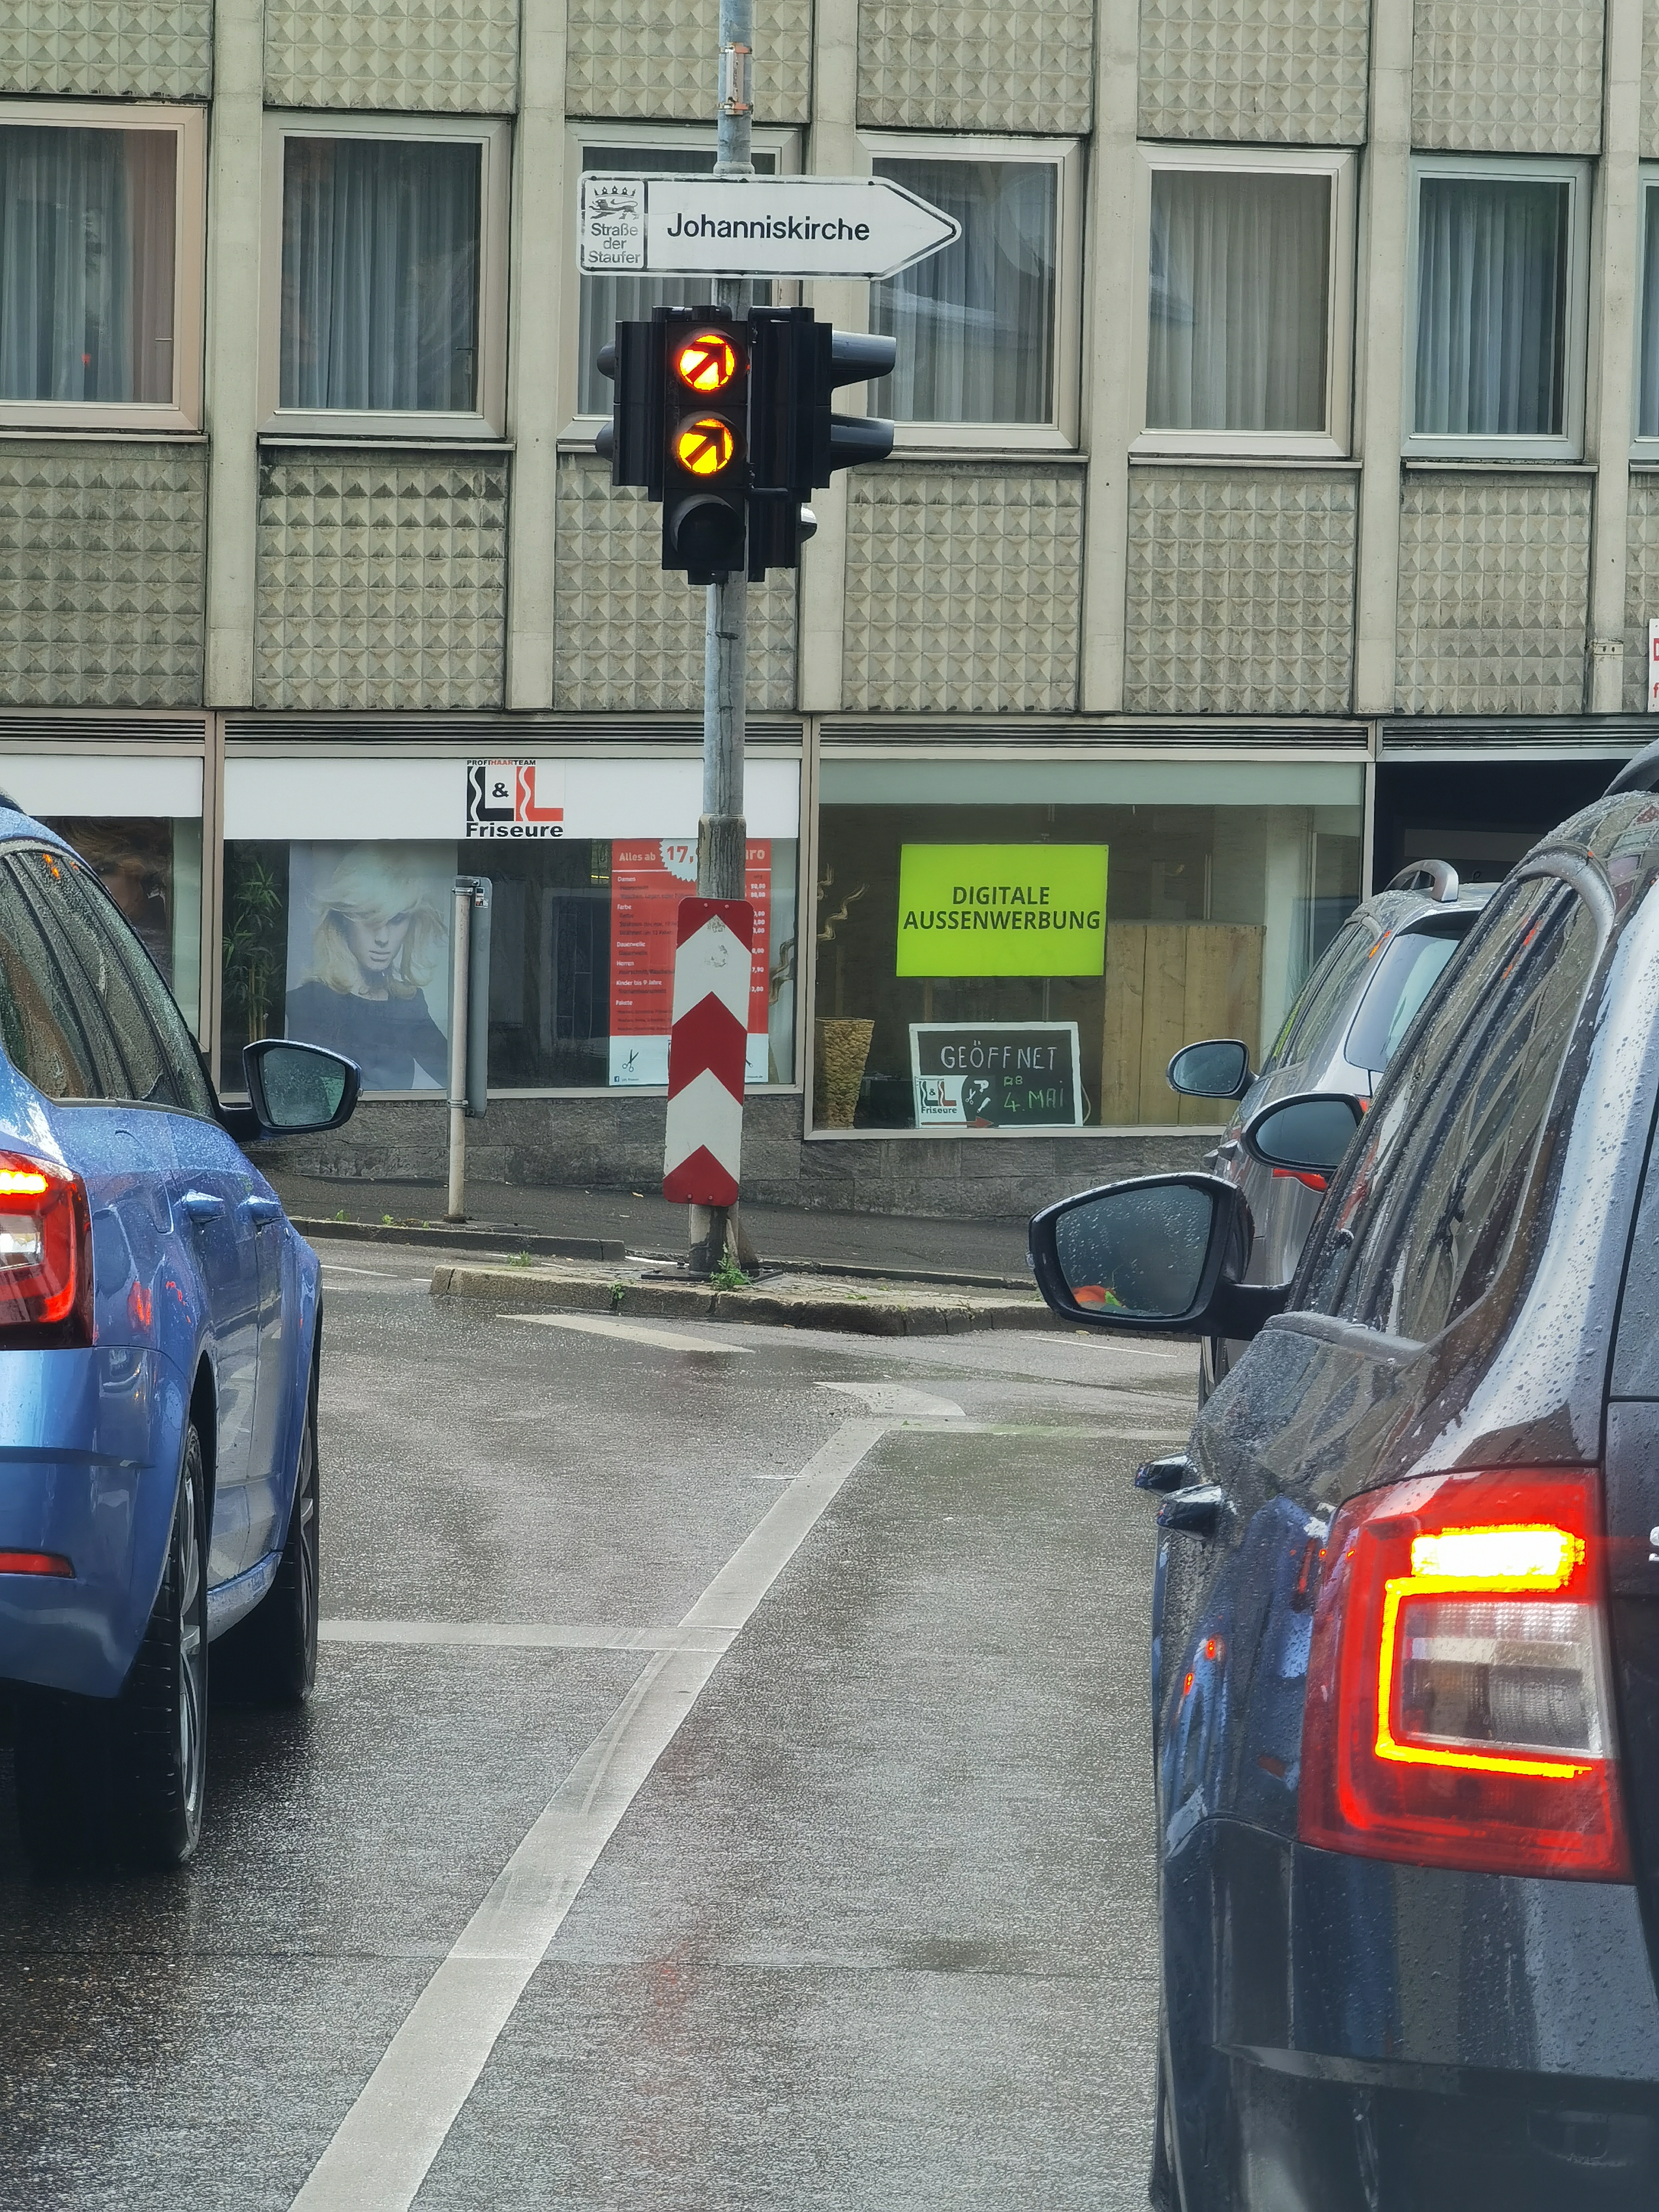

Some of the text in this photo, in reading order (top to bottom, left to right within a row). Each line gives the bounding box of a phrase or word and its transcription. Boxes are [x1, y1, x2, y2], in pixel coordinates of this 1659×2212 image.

[591, 222, 638, 236] Straße
[666, 213, 870, 241] Johanniskirche
[603, 237, 626, 249] der
[588, 251, 641, 263] Staufer
[466, 822, 563, 838] Friseure
[619, 852, 643, 861] Alles
[644, 852, 656, 861] ab
[667, 846, 698, 864] 17,
[953, 886, 1050, 905] DIGITALE
[903, 911, 1101, 929] AUSSENWERBUNG
[940, 1040, 1057, 1070] GEÖFFNET
